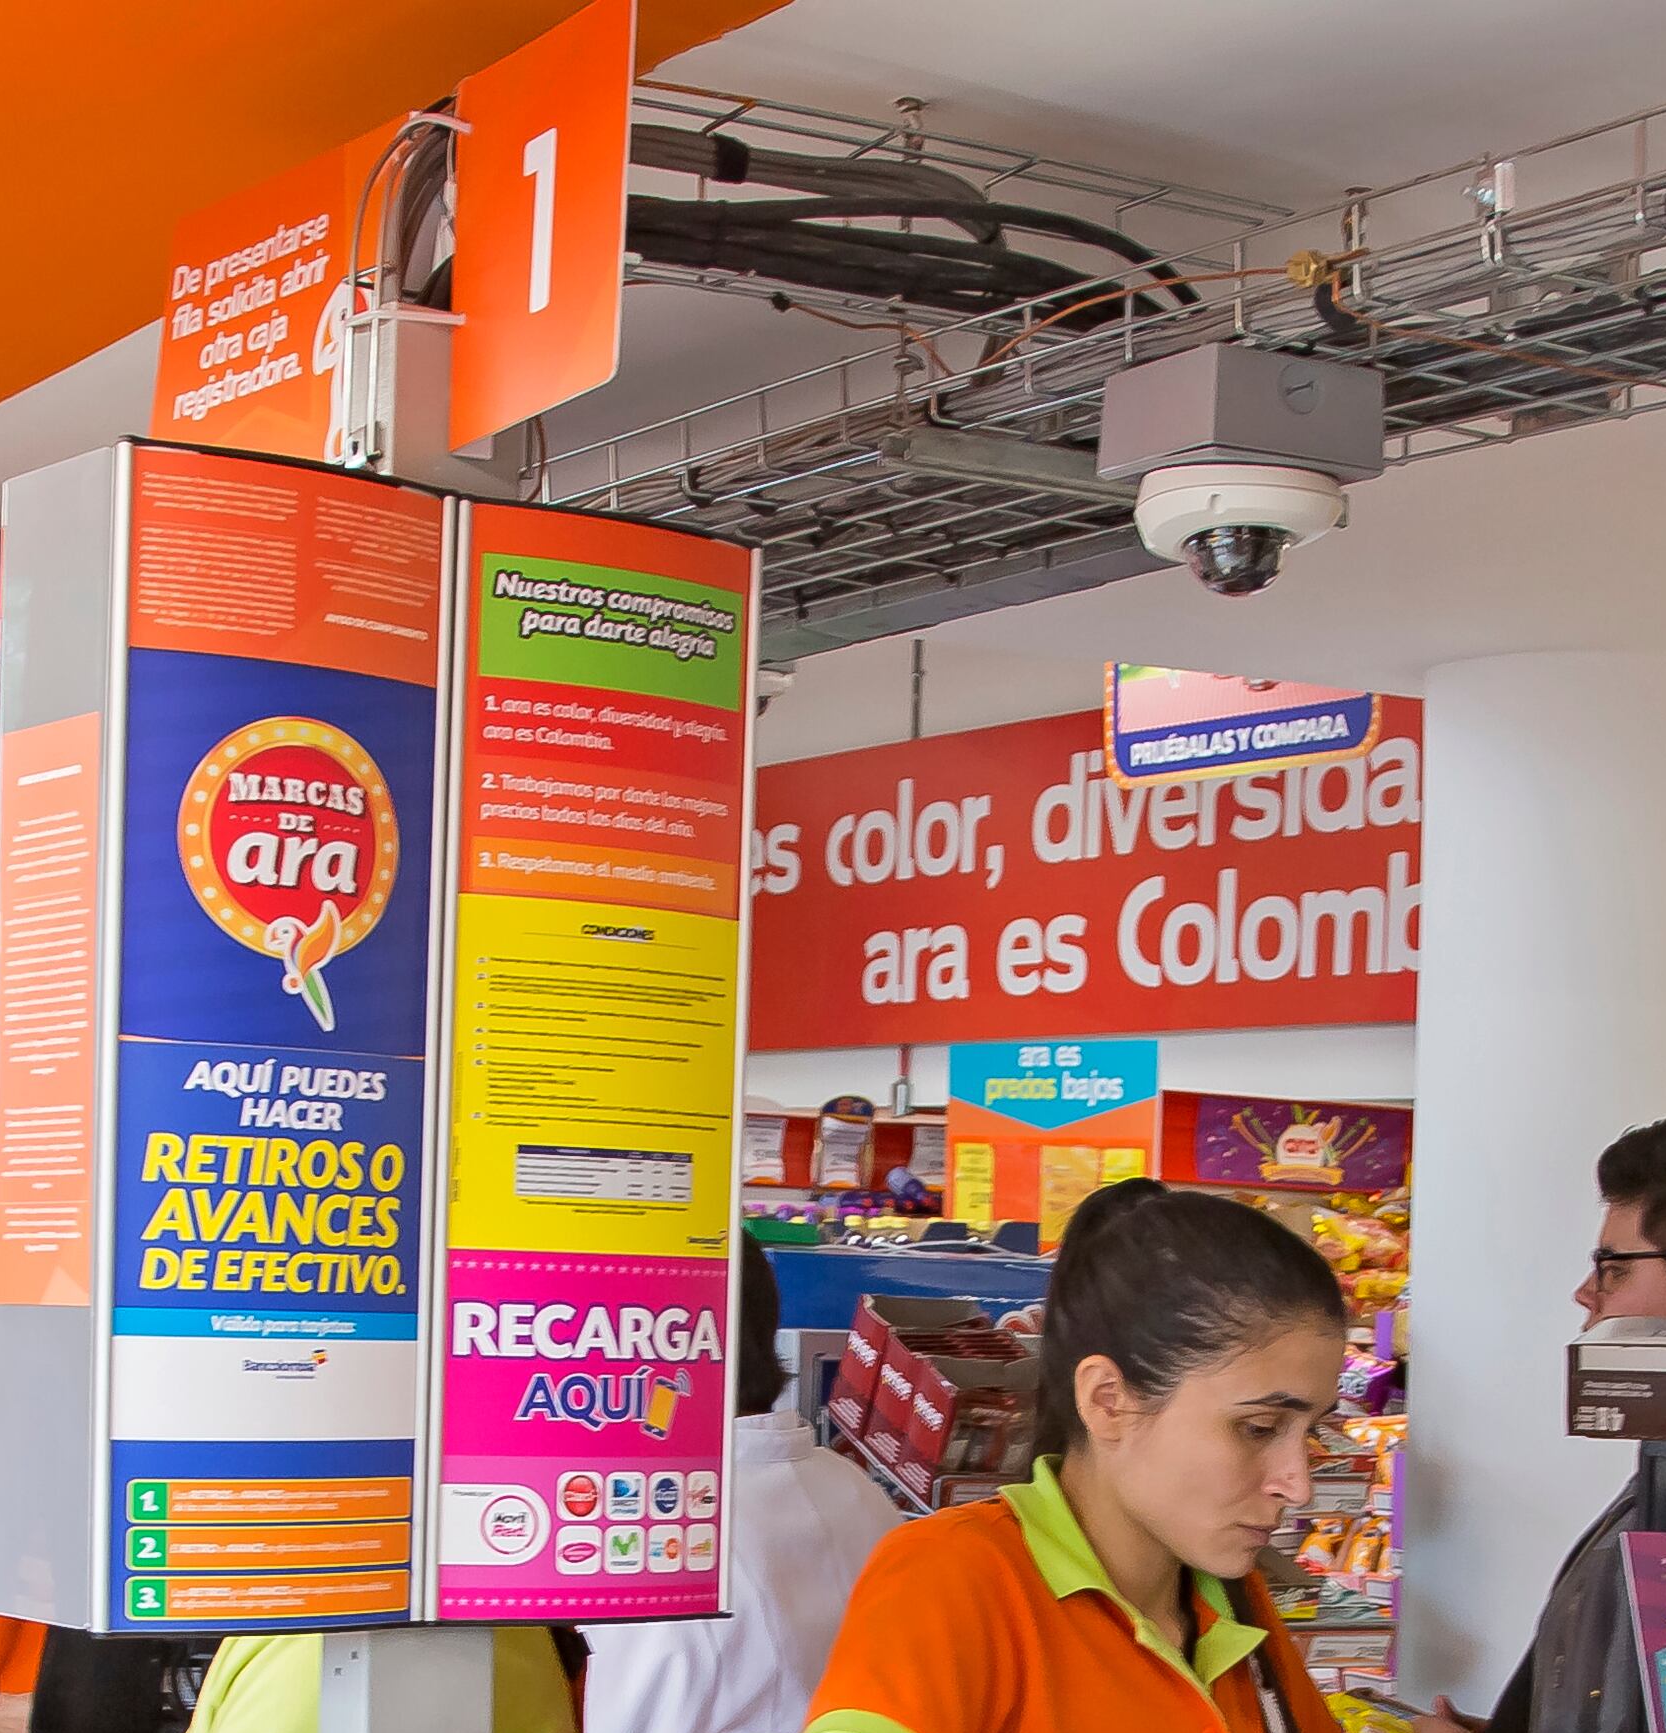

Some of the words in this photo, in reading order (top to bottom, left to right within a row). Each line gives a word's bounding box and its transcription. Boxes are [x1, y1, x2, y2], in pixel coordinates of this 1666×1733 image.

[522, 126, 558, 314] 1
[172, 264, 203, 300] De
[203, 214, 330, 297] presentarse
[172, 302, 204, 341] fila
[206, 274, 277, 328] solicita
[279, 248, 331, 298] abrir
[199, 331, 243, 370] otra
[247, 309, 289, 353] caja
[172, 353, 303, 421] registradora.
[493, 570, 607, 607] Nuestros
[606, 591, 735, 633] compromisos
[519, 607, 582, 638] para
[583, 611, 648, 646] darte
[648, 623, 717, 661] alegría
[1251, 713, 1351, 750] COMPARA
[227, 770, 366, 816] MARCAS
[825, 778, 1005, 890] color,
[1033, 735, 1421, 865] diversida
[277, 811, 315, 834] DE
[226, 830, 360, 895] ara
[862, 920, 969, 1005] ara
[995, 912, 1089, 998] es
[1116, 851, 1421, 988] Colomb
[184, 1058, 275, 1096] AQUÍ
[278, 1065, 387, 1102] PUEDES
[1054, 1045, 1082, 1067] es
[239, 1096, 344, 1131] HACER
[1061, 1070, 1124, 1107] bajos
[140, 1133, 367, 1187] RETIROS
[367, 1143, 406, 1187] O
[140, 1189, 402, 1250] AVANCES
[139, 1246, 206, 1291] DE
[213, 1249, 408, 1296] EFECTIVO.
[451, 1301, 723, 1362] RECARGA
[513, 1367, 647, 1430] AQUÍ
[139, 1490, 159, 1513] 1
[136, 1536, 162, 1559] 2
[137, 1587, 161, 1610] 3
